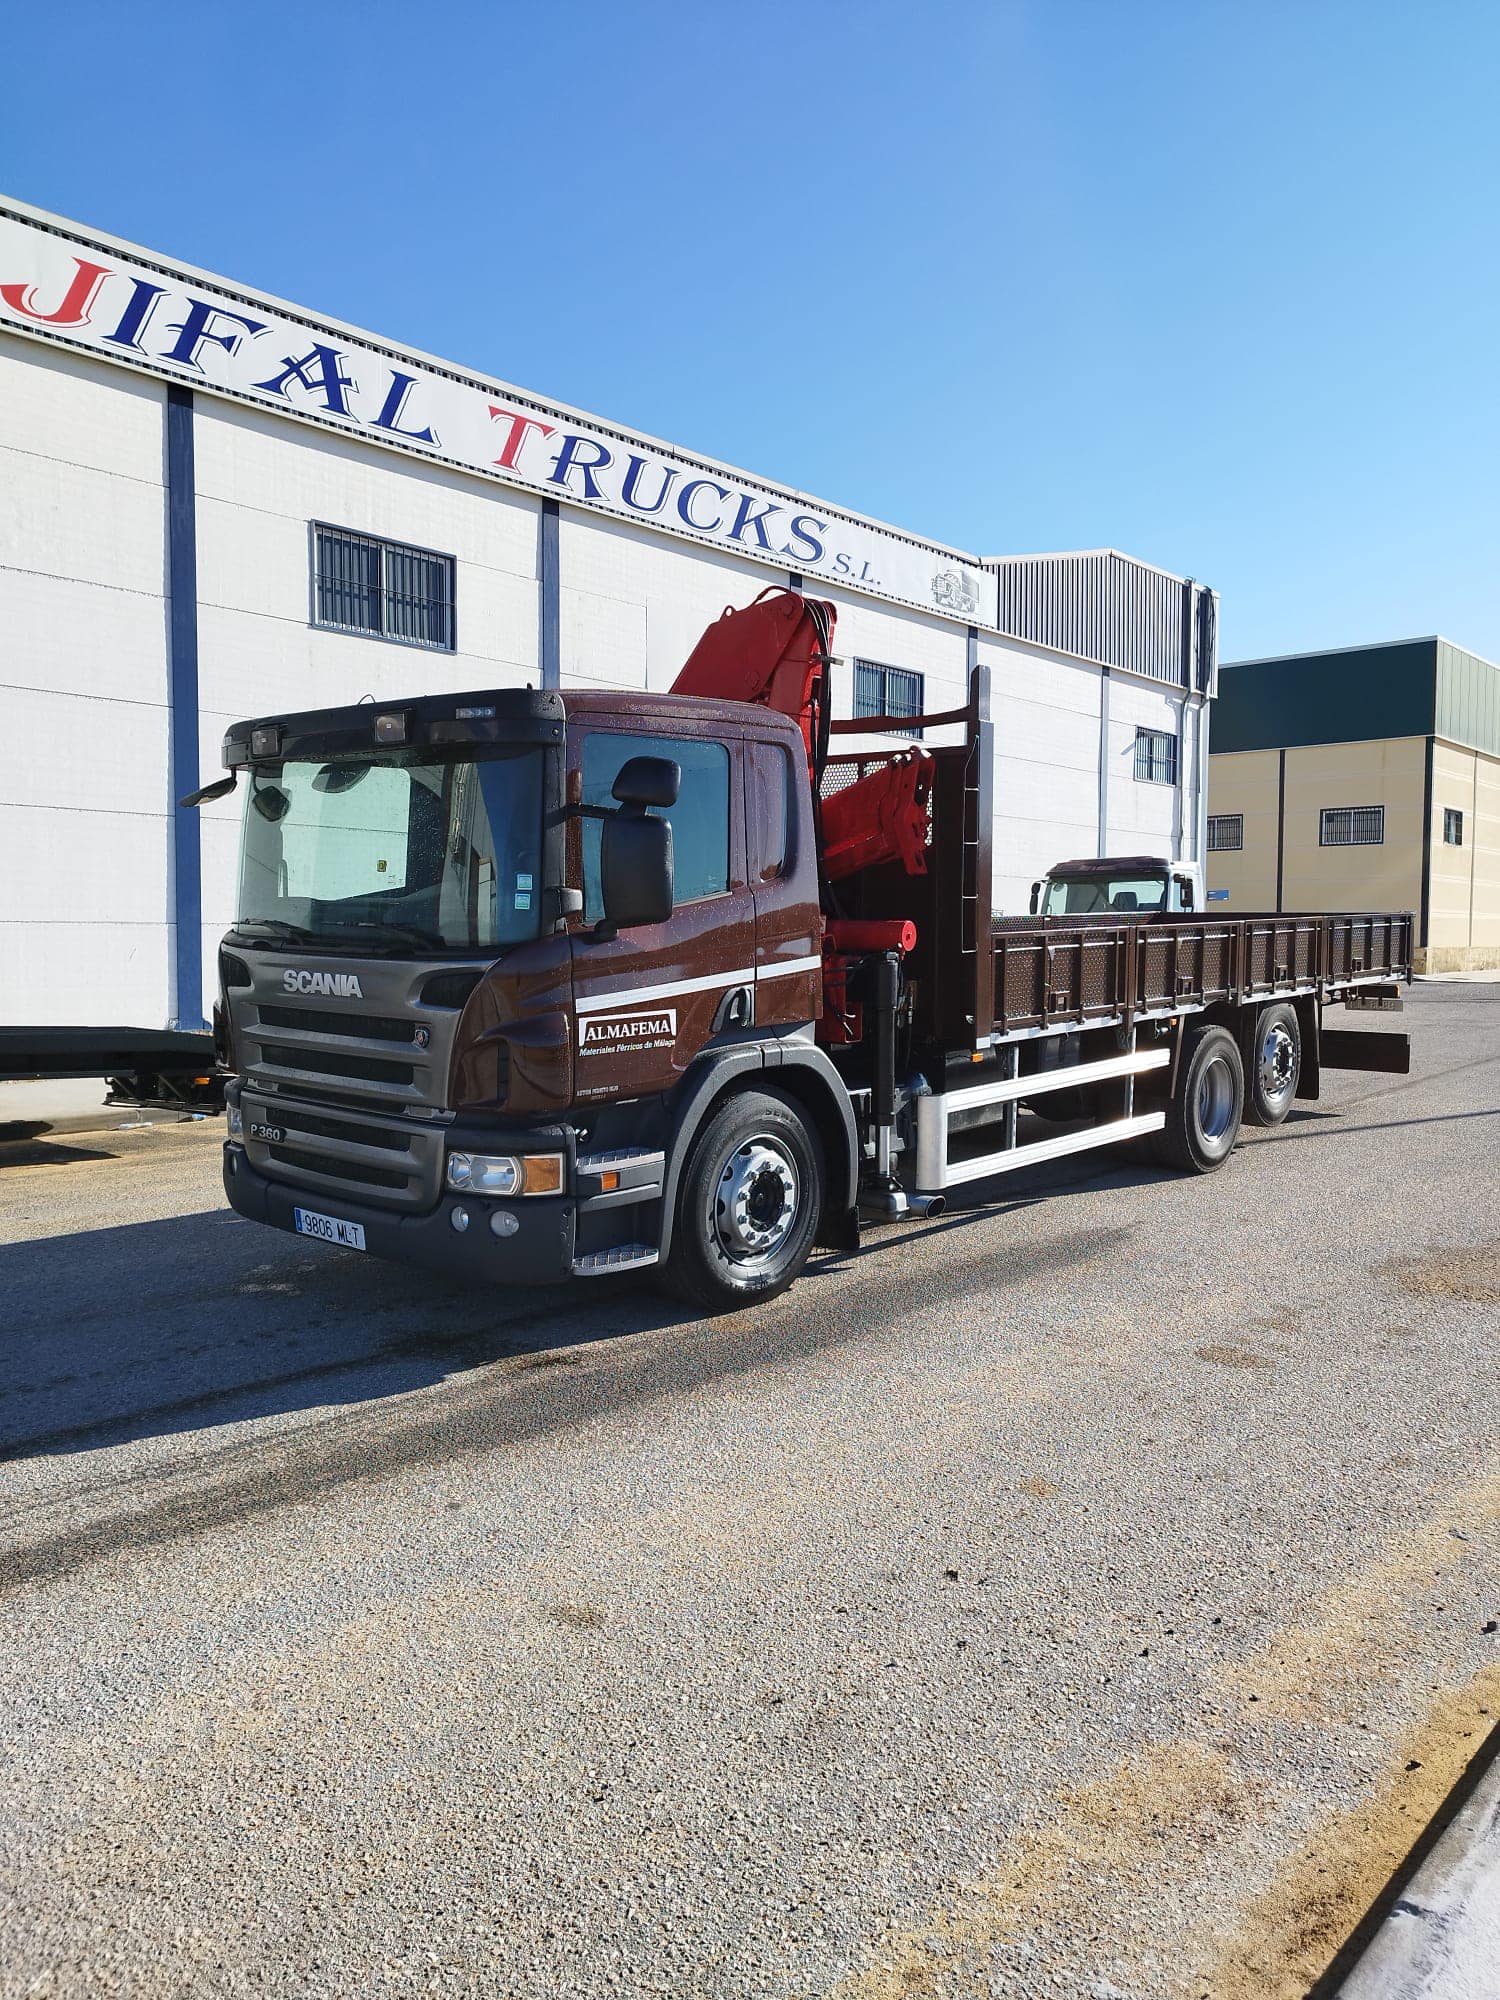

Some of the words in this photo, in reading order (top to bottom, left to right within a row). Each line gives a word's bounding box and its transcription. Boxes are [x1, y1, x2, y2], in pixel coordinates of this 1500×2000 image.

[0, 257, 441, 448] JIFAL
[488, 405, 832, 565] TRUCKS
[831, 552, 881, 586] S.L.
[283, 969, 363, 998] SCANIA
[585, 1019, 670, 1041] ALMAFEMA
[579, 1046, 616, 1057] Materiales
[644, 1040, 653, 1049] de
[250, 1124, 258, 1135] P
[259, 1126, 280, 1141] 360
[304, 1214, 333, 1238] 9806
